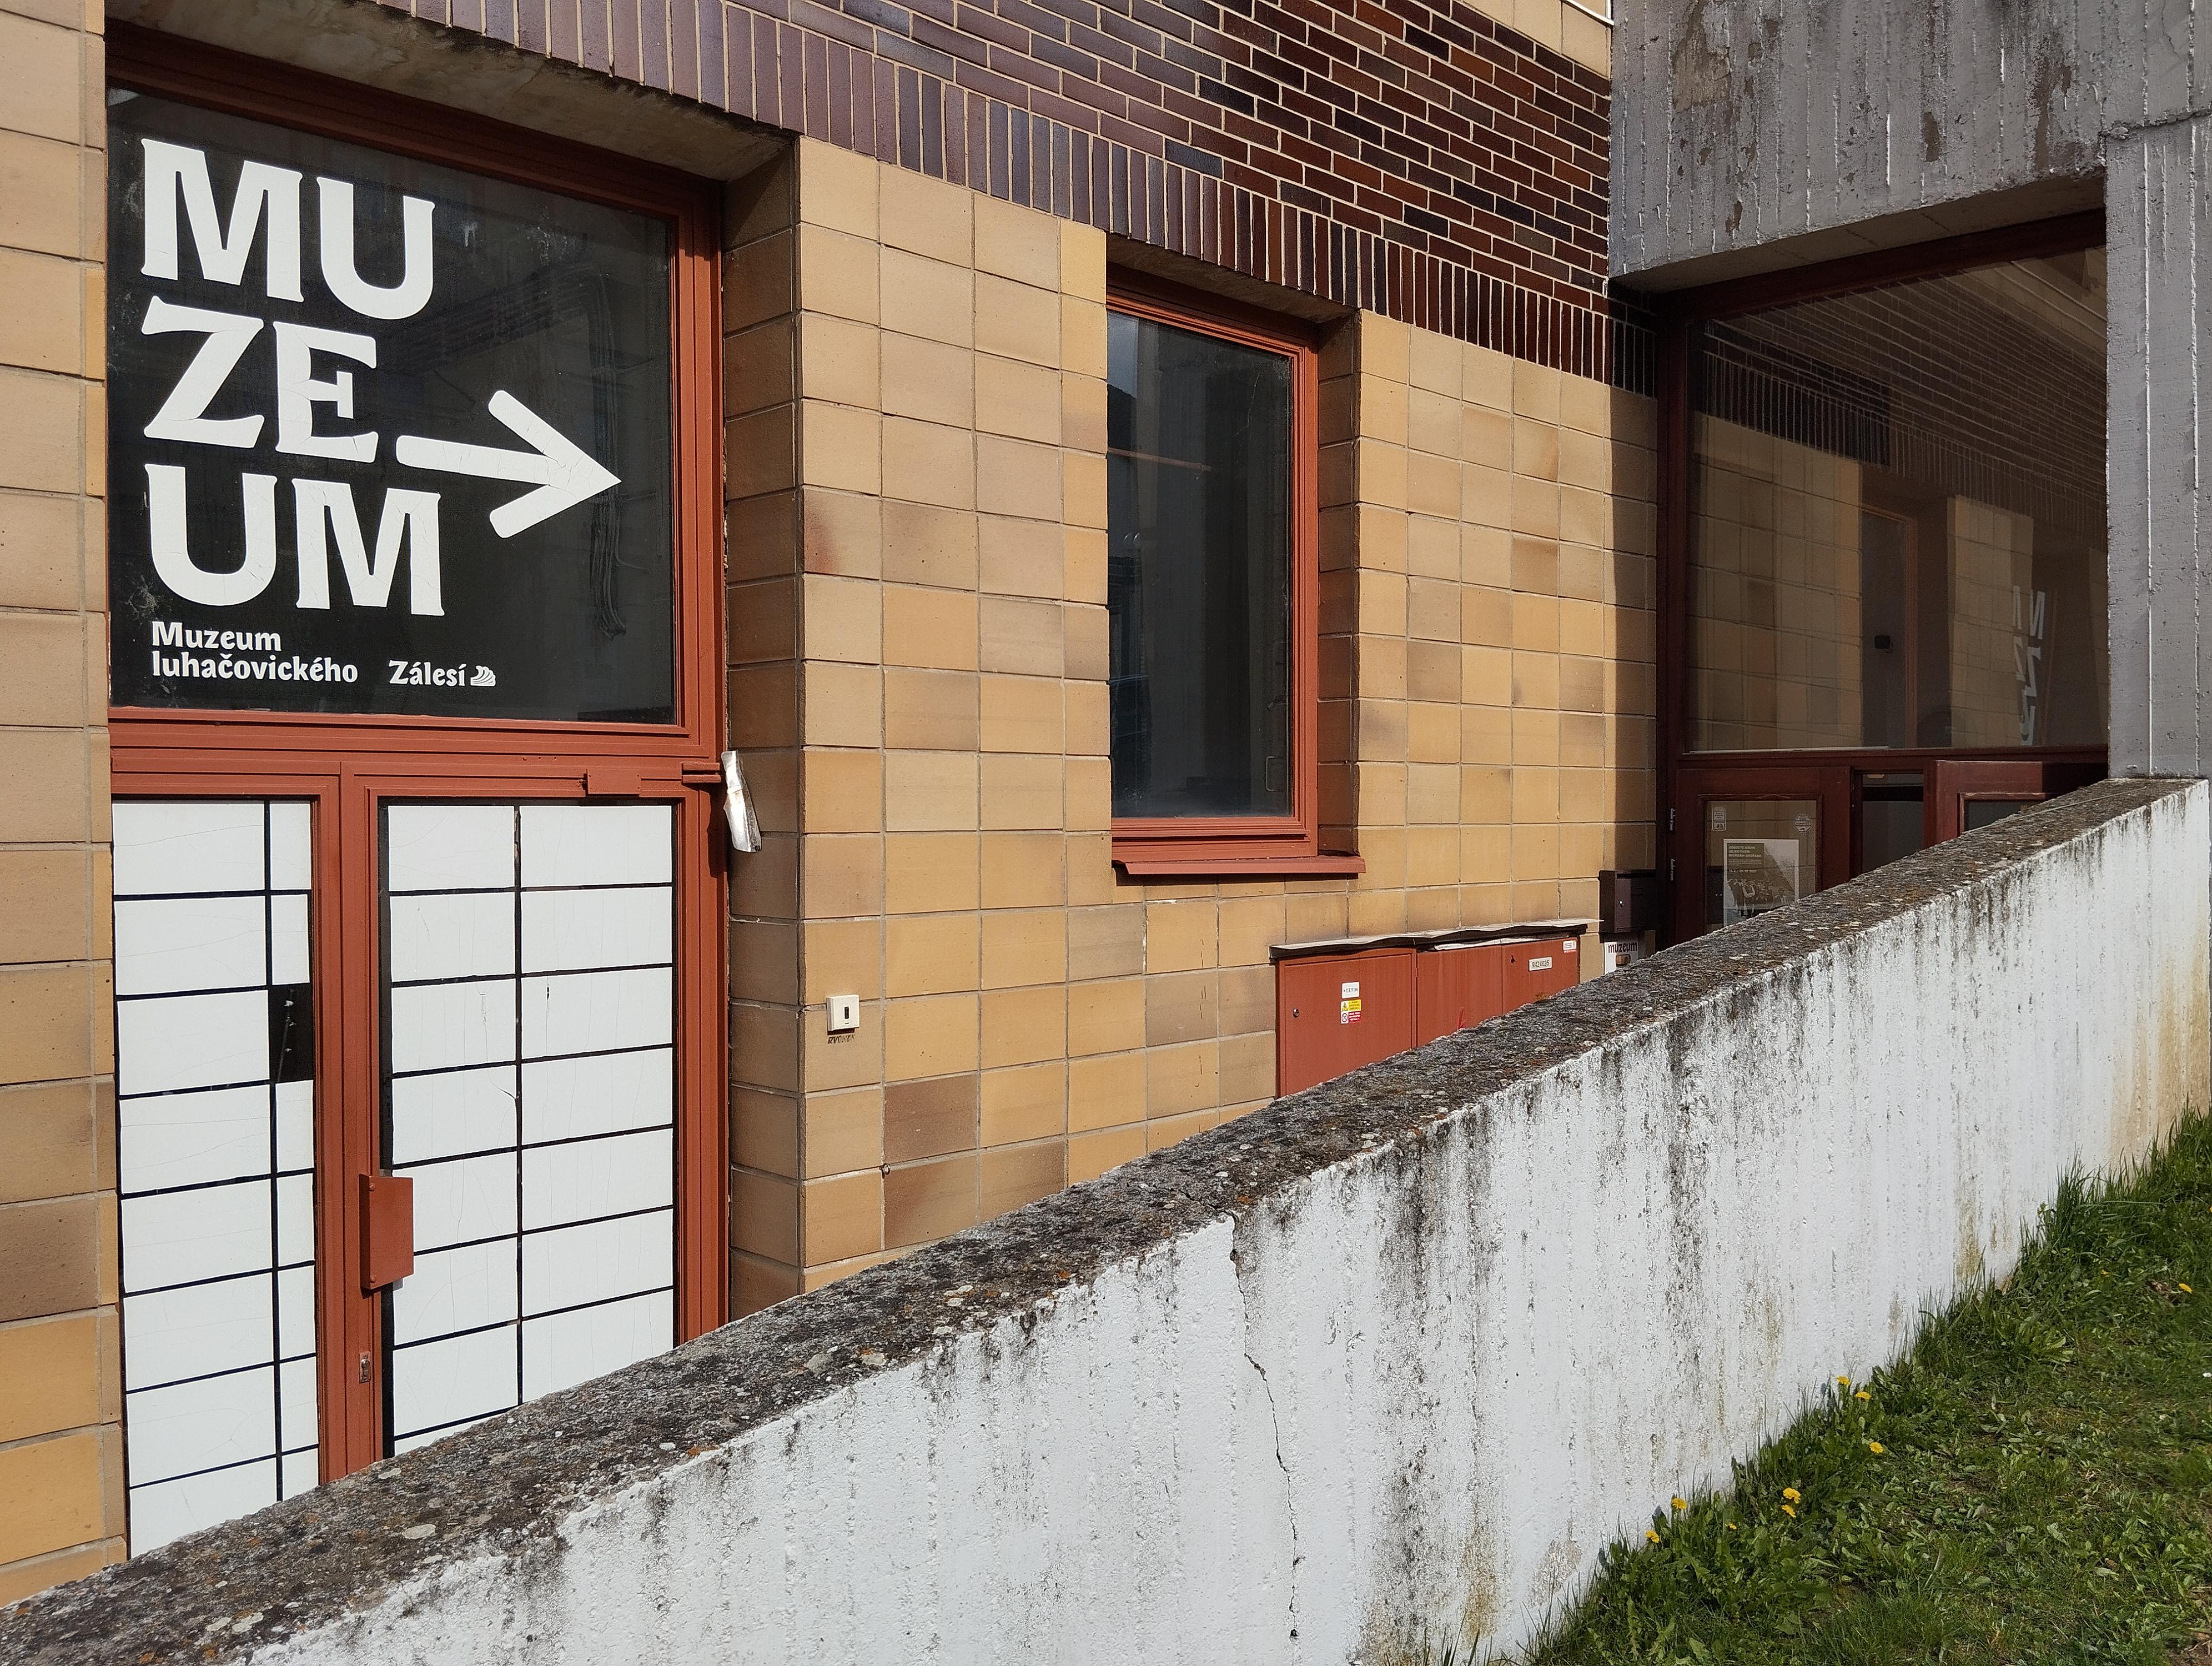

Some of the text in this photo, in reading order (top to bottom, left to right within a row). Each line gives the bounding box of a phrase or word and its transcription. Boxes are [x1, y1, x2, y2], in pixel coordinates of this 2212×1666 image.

[141, 138, 435, 320] MU
[142, 296, 379, 463] ZE
[144, 463, 445, 616] UM
[152, 621, 281, 651] Muzeum
[152, 650, 467, 686] luhačovického Zálesí
[1608, 942, 1637, 954] muzeum
